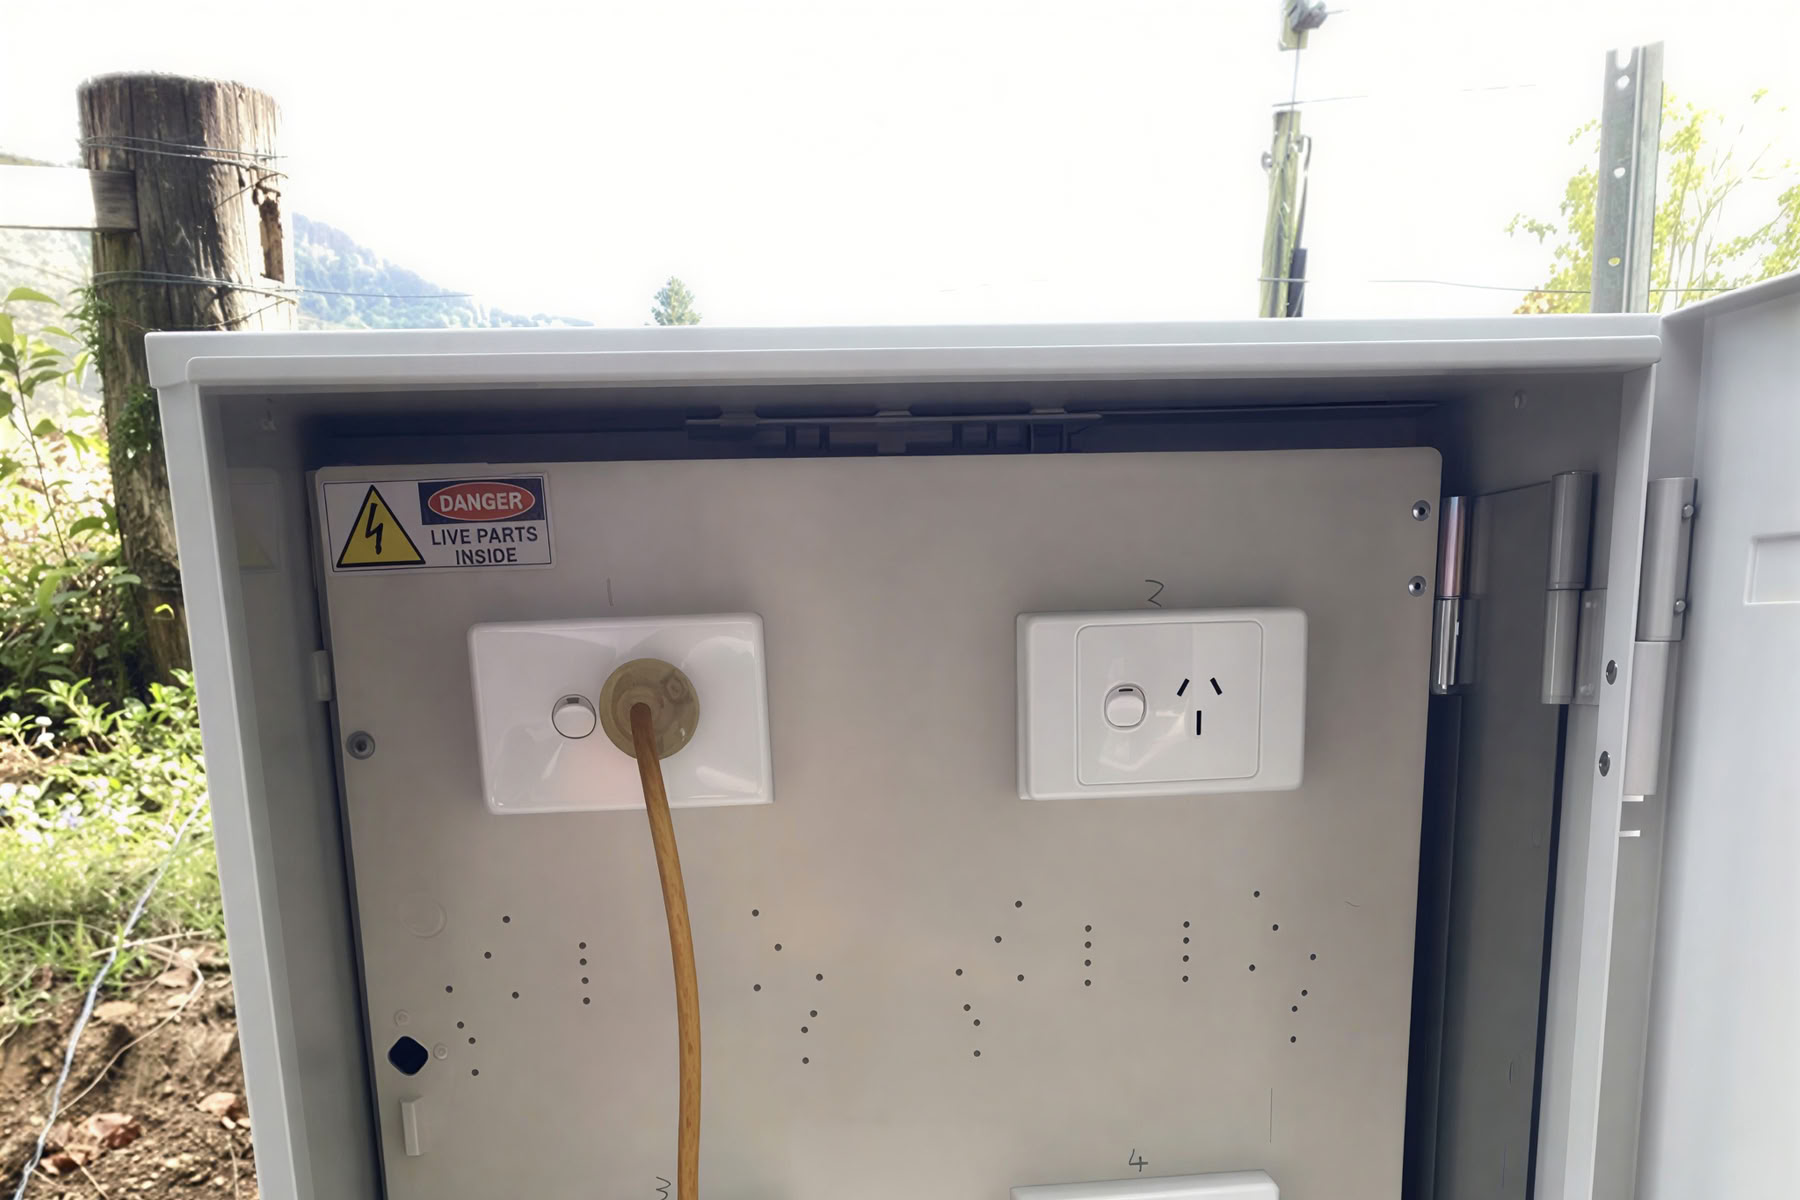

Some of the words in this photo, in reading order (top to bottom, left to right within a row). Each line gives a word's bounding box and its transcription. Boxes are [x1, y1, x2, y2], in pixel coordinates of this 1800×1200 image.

[440, 491, 523, 513] DANGER
[431, 528, 471, 545] LIVE
[477, 526, 538, 544] PARTS
[456, 547, 518, 565] INSIDE
[1144, 579, 1165, 608] 2
[1128, 1148, 1149, 1173] 4
